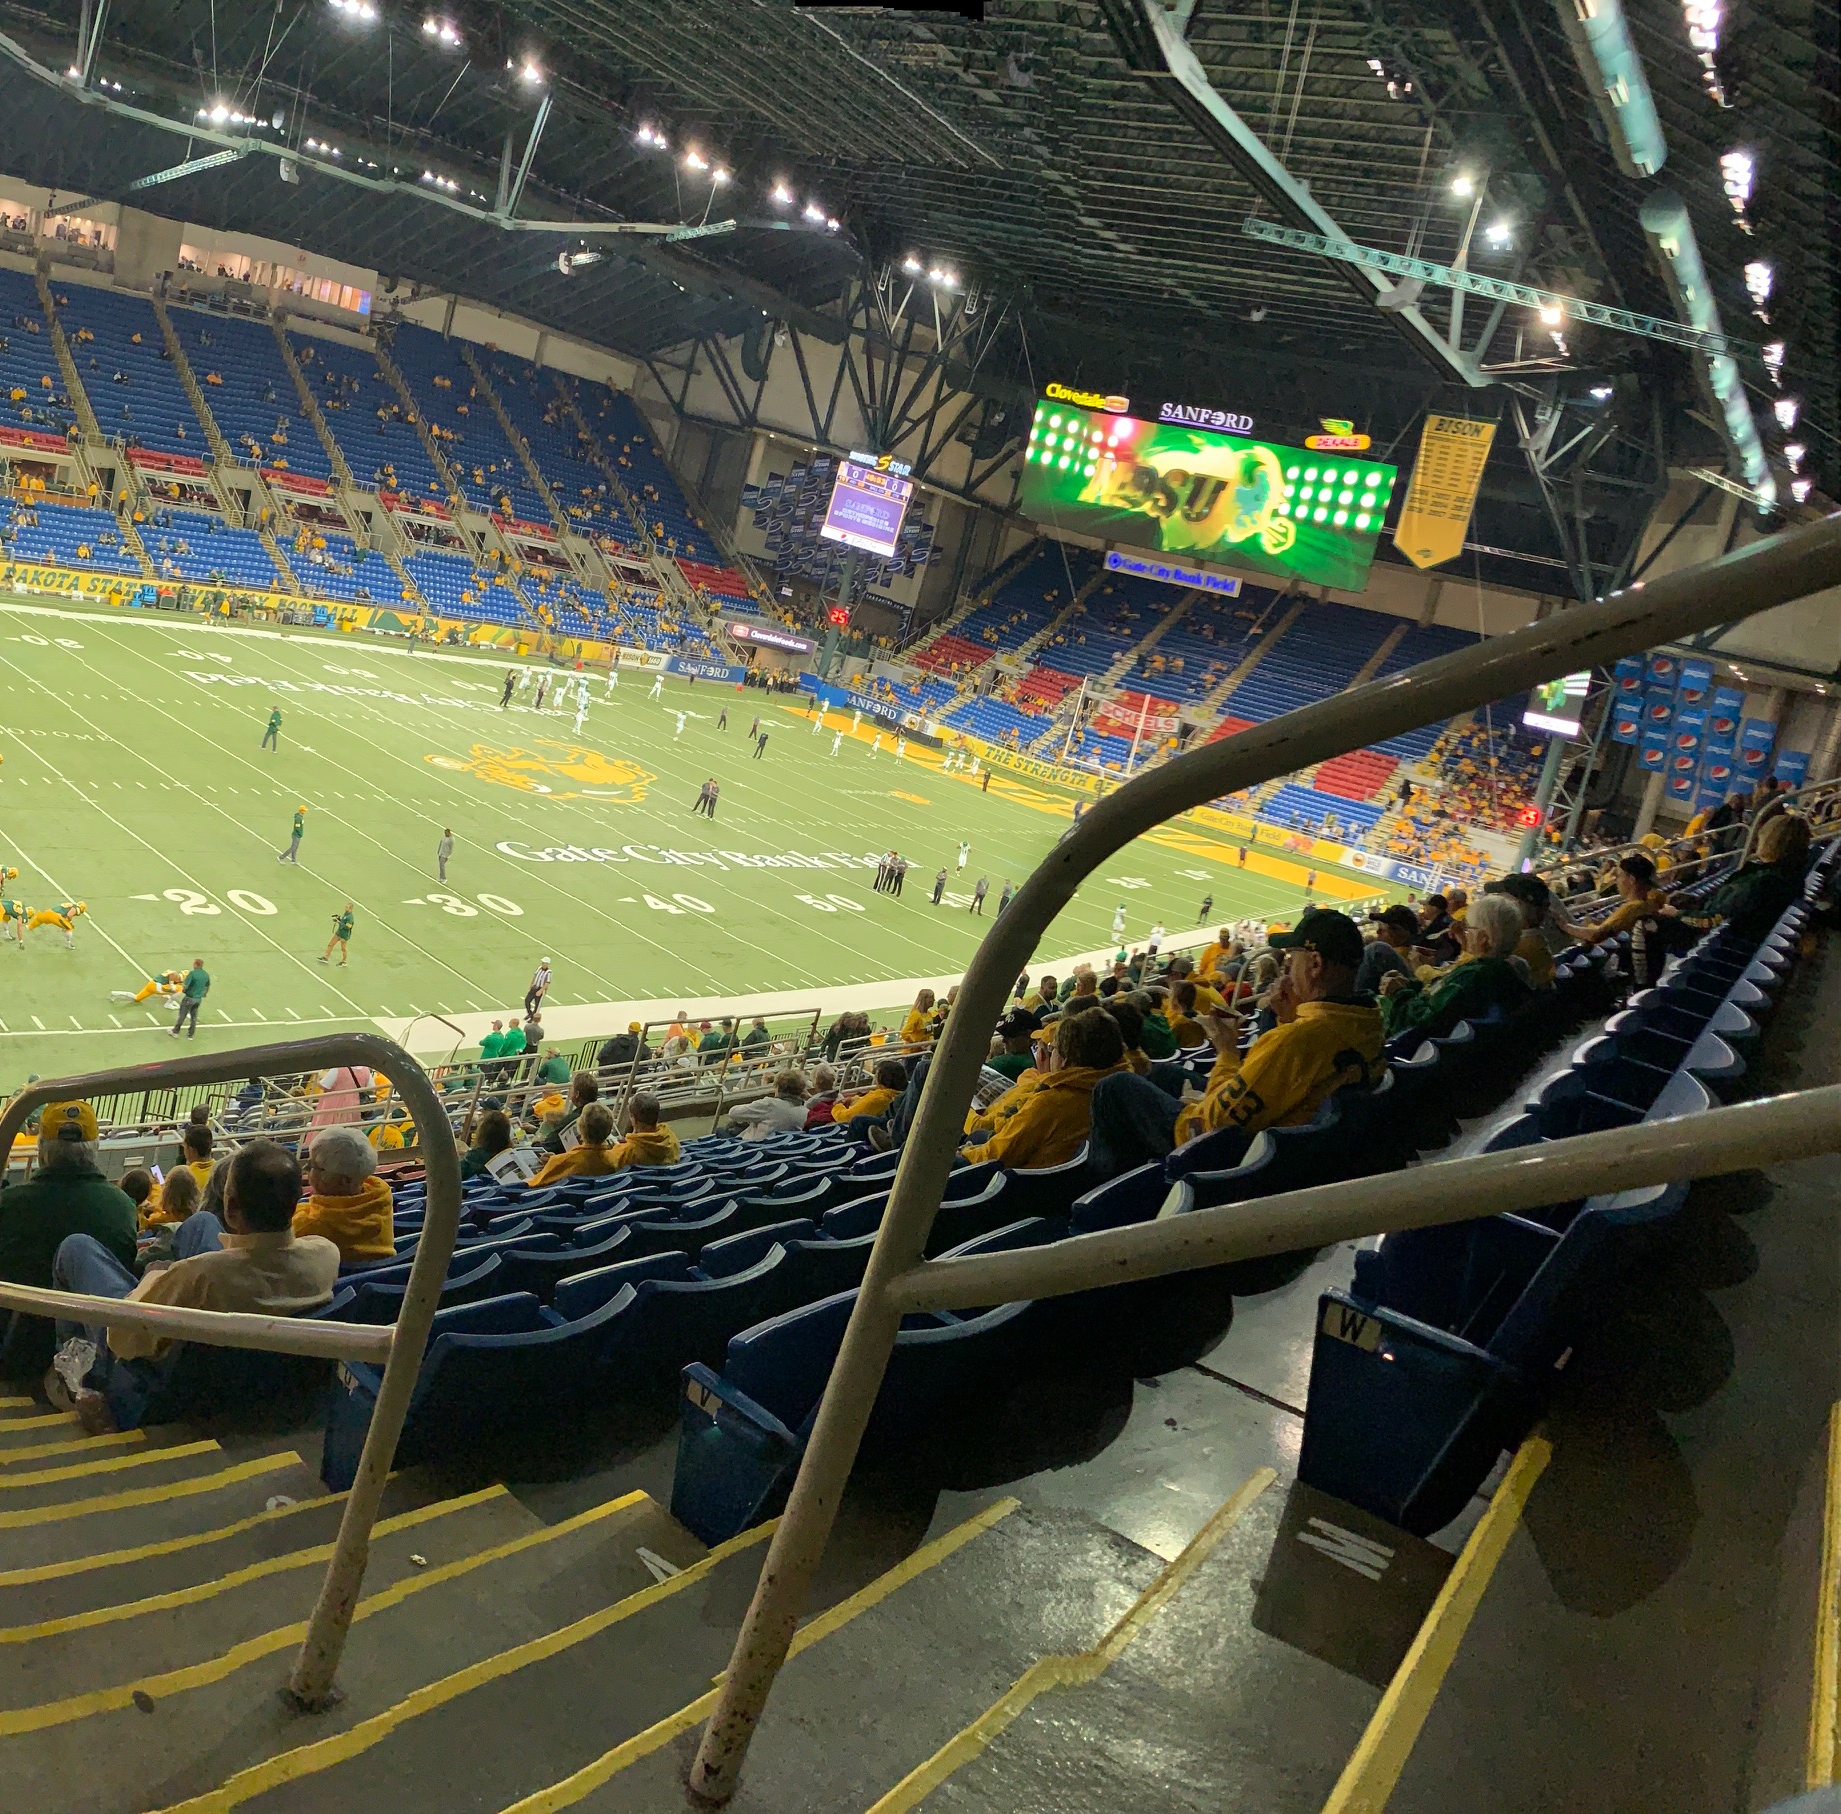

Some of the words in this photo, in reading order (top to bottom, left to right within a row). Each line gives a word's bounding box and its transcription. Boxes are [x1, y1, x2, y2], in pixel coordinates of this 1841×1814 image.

[1160, 402, 1253, 431] SANFORD
[1435, 418, 1485, 438] BISON
[852, 470, 859, 479] 0
[891, 483, 898, 491] 0
[888, 461, 911, 476] STAR
[1122, 557, 1148, 573] Gate
[1147, 563, 1171, 583] City
[1173, 568, 1203, 587] Bank
[1205, 575, 1236, 593] Field
[86, 577, 143, 599] STAT
[277, 597, 359, 623] FOOTALL
[831, 610, 847, 624] 25
[751, 629, 808, 651] CloverdaleFoods.com
[678, 662, 730, 679] SANFORD
[846, 693, 898, 721] SANFORD
[1102, 701, 1176, 731] SCHEELS
[985, 746, 1012, 767] THE
[1013, 755, 1089, 790] STRENGTH
[495, 840, 630, 864] Gate
[620, 844, 731, 872] City
[715, 850, 834, 870] Bank
[829, 851, 925, 870] Fie
[162, 888, 279, 917] 20
[426, 892, 525, 917] 30
[647, 892, 717, 915] 40
[791, 892, 866, 913] 50
[1217, 1072, 1266, 1127] 23
[1339, 1308, 1368, 1344] W
